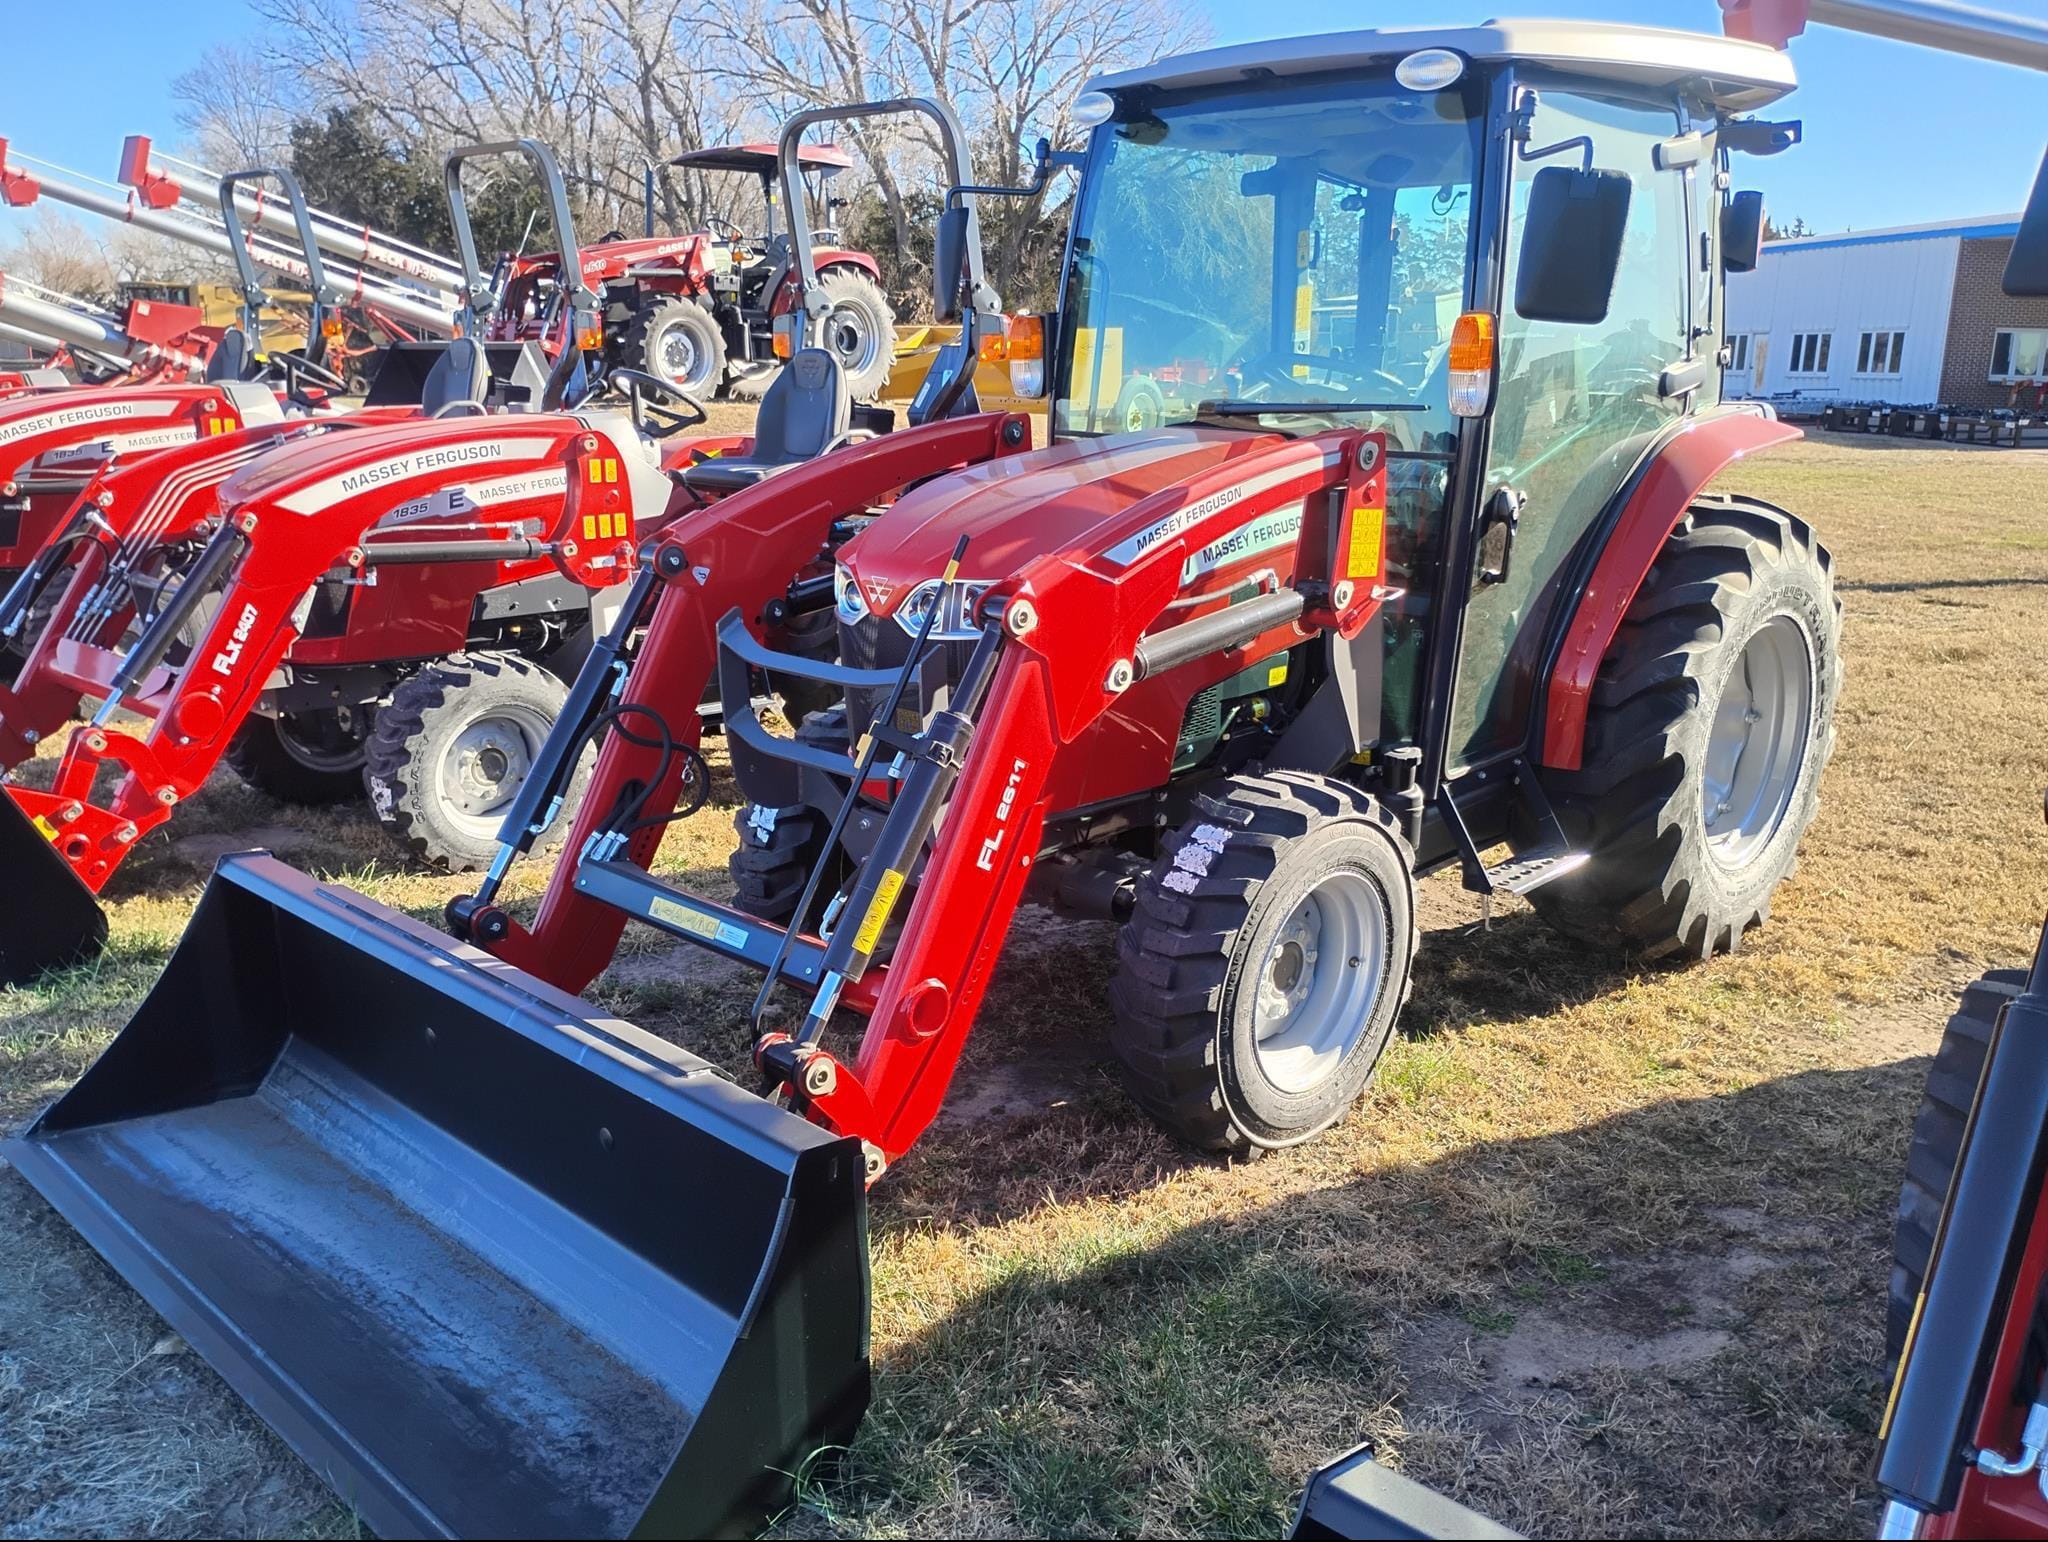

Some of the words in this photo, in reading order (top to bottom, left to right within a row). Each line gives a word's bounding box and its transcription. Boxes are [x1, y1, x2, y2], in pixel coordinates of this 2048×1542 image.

[658, 242, 684, 254] CASE
[0, 417, 53, 441] MASSEY
[58, 405, 133, 424] FERGUSON
[101, 440, 114, 453] E
[128, 434, 170, 447] MASSEY
[341, 459, 410, 493] MASSEY
[416, 444, 502, 470] FERGUSON
[393, 502, 428, 518] 1835
[449, 489, 465, 510] E
[479, 482, 527, 500] MASSEY
[1136, 515, 1182, 551] MASSEY
[1186, 485, 1243, 523] FERGUSON
[1202, 533, 1249, 563] MASSEY
[211, 639, 243, 676] FLX
[976, 829, 1004, 872] FL
[996, 759, 1026, 822] 2611
